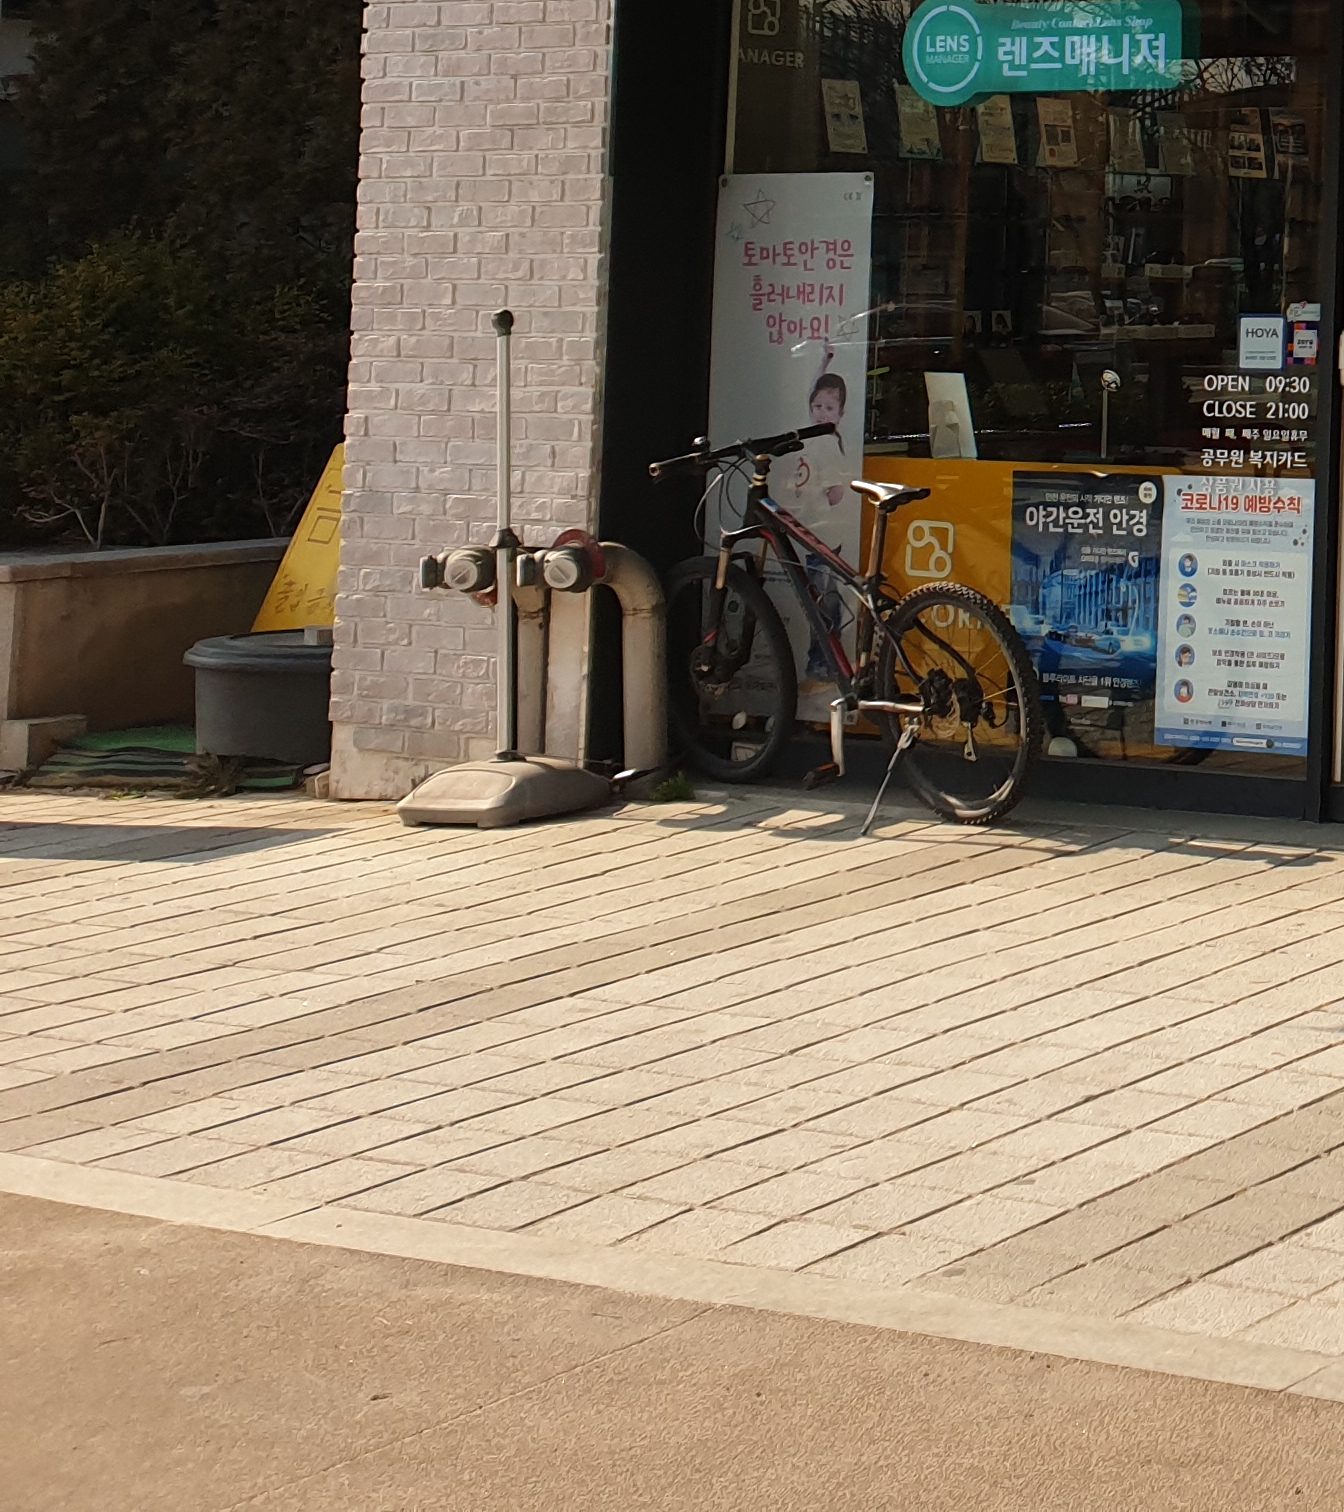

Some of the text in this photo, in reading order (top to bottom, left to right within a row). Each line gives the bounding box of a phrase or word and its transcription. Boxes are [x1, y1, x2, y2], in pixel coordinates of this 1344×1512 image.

[925, 35, 970, 53] LENS
[925, 54, 970, 65] MANAGER
[997, 32, 1166, 77] 렌즈매니져
[742, 239, 854, 272] 토마토안경은
[750, 275, 844, 311] 흘러내리지
[1245, 328, 1279, 339] HOYA
[1204, 375, 1310, 393] OPEN 09:30
[1203, 400, 1309, 420] CLOSE 21:00
[1200, 448, 1308, 469] 공무원 복지카드
[1200, 477, 1277, 496] 상품권 사용
[1181, 493, 1302, 515] 코로나19 예방수칙
[1025, 505, 1148, 537] 야간운전 안경
